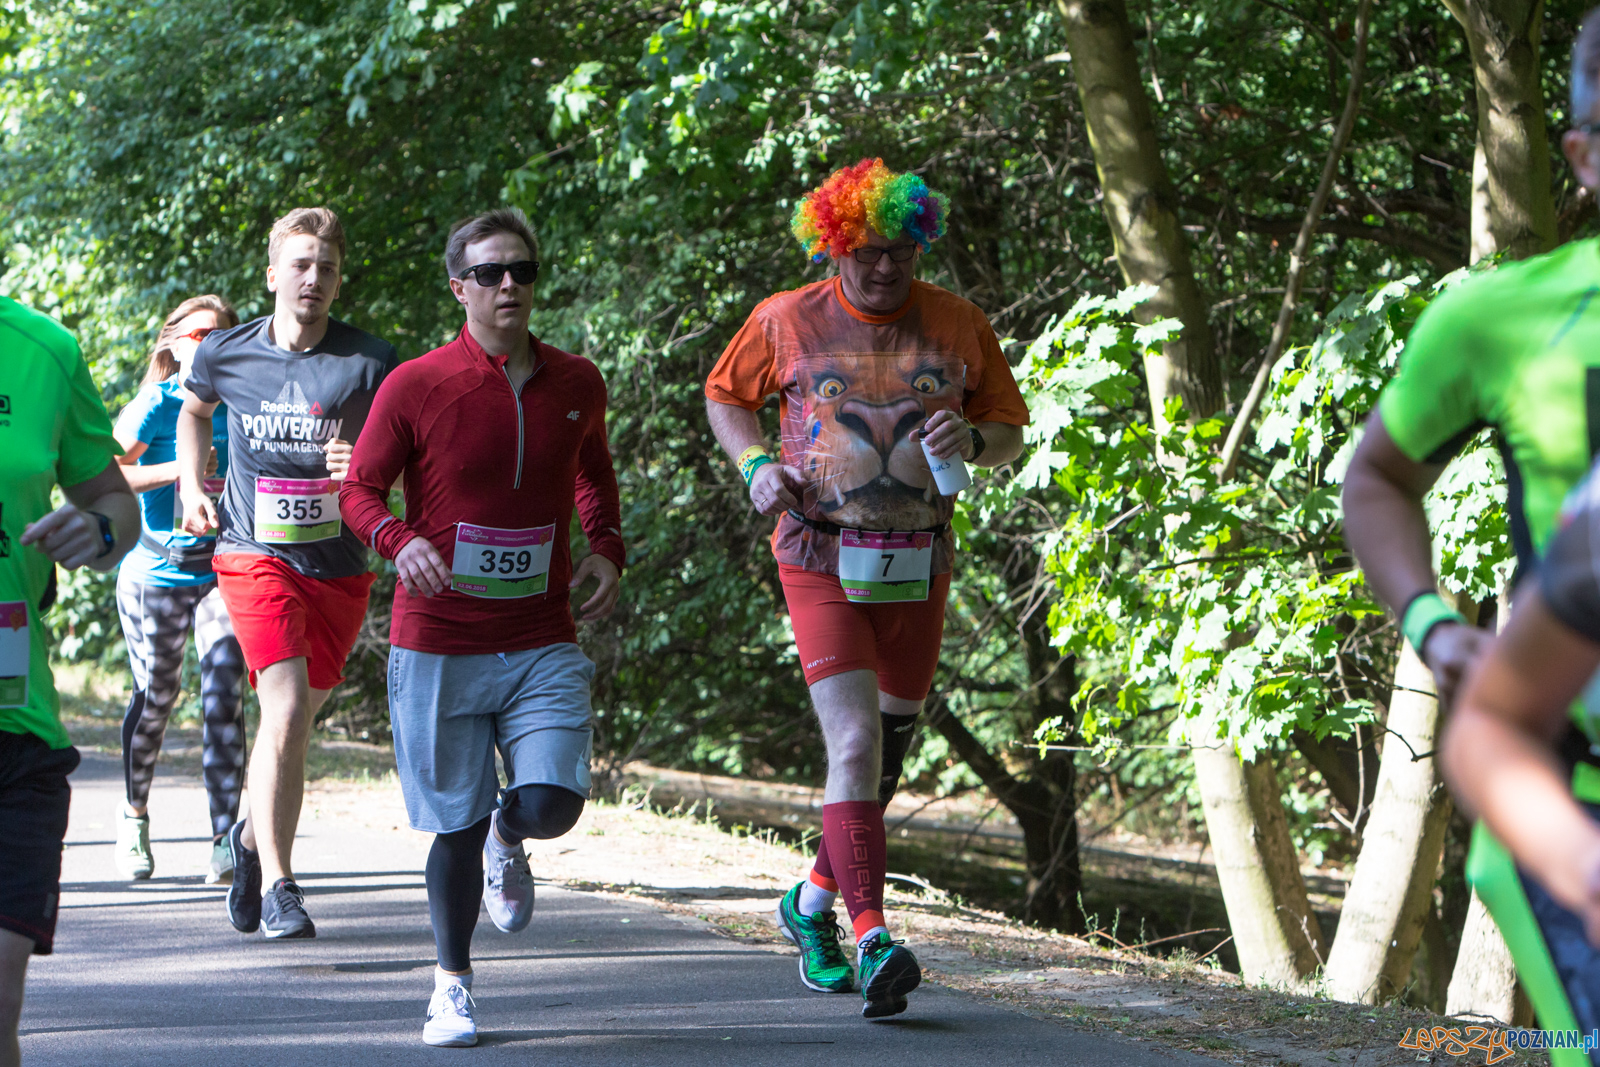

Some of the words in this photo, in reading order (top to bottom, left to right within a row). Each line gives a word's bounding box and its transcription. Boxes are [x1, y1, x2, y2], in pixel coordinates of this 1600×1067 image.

[260, 400, 308, 415] Reebok
[566, 410, 580, 421] 4F
[241, 413, 344, 441] POWERUN
[249, 438, 262, 450] BY
[263, 441, 325, 454] RUNMAGEDO
[276, 498, 323, 520] 355
[479, 549, 532, 574] 359
[881, 553, 895, 577] 7
[841, 819, 872, 904] kalenji
